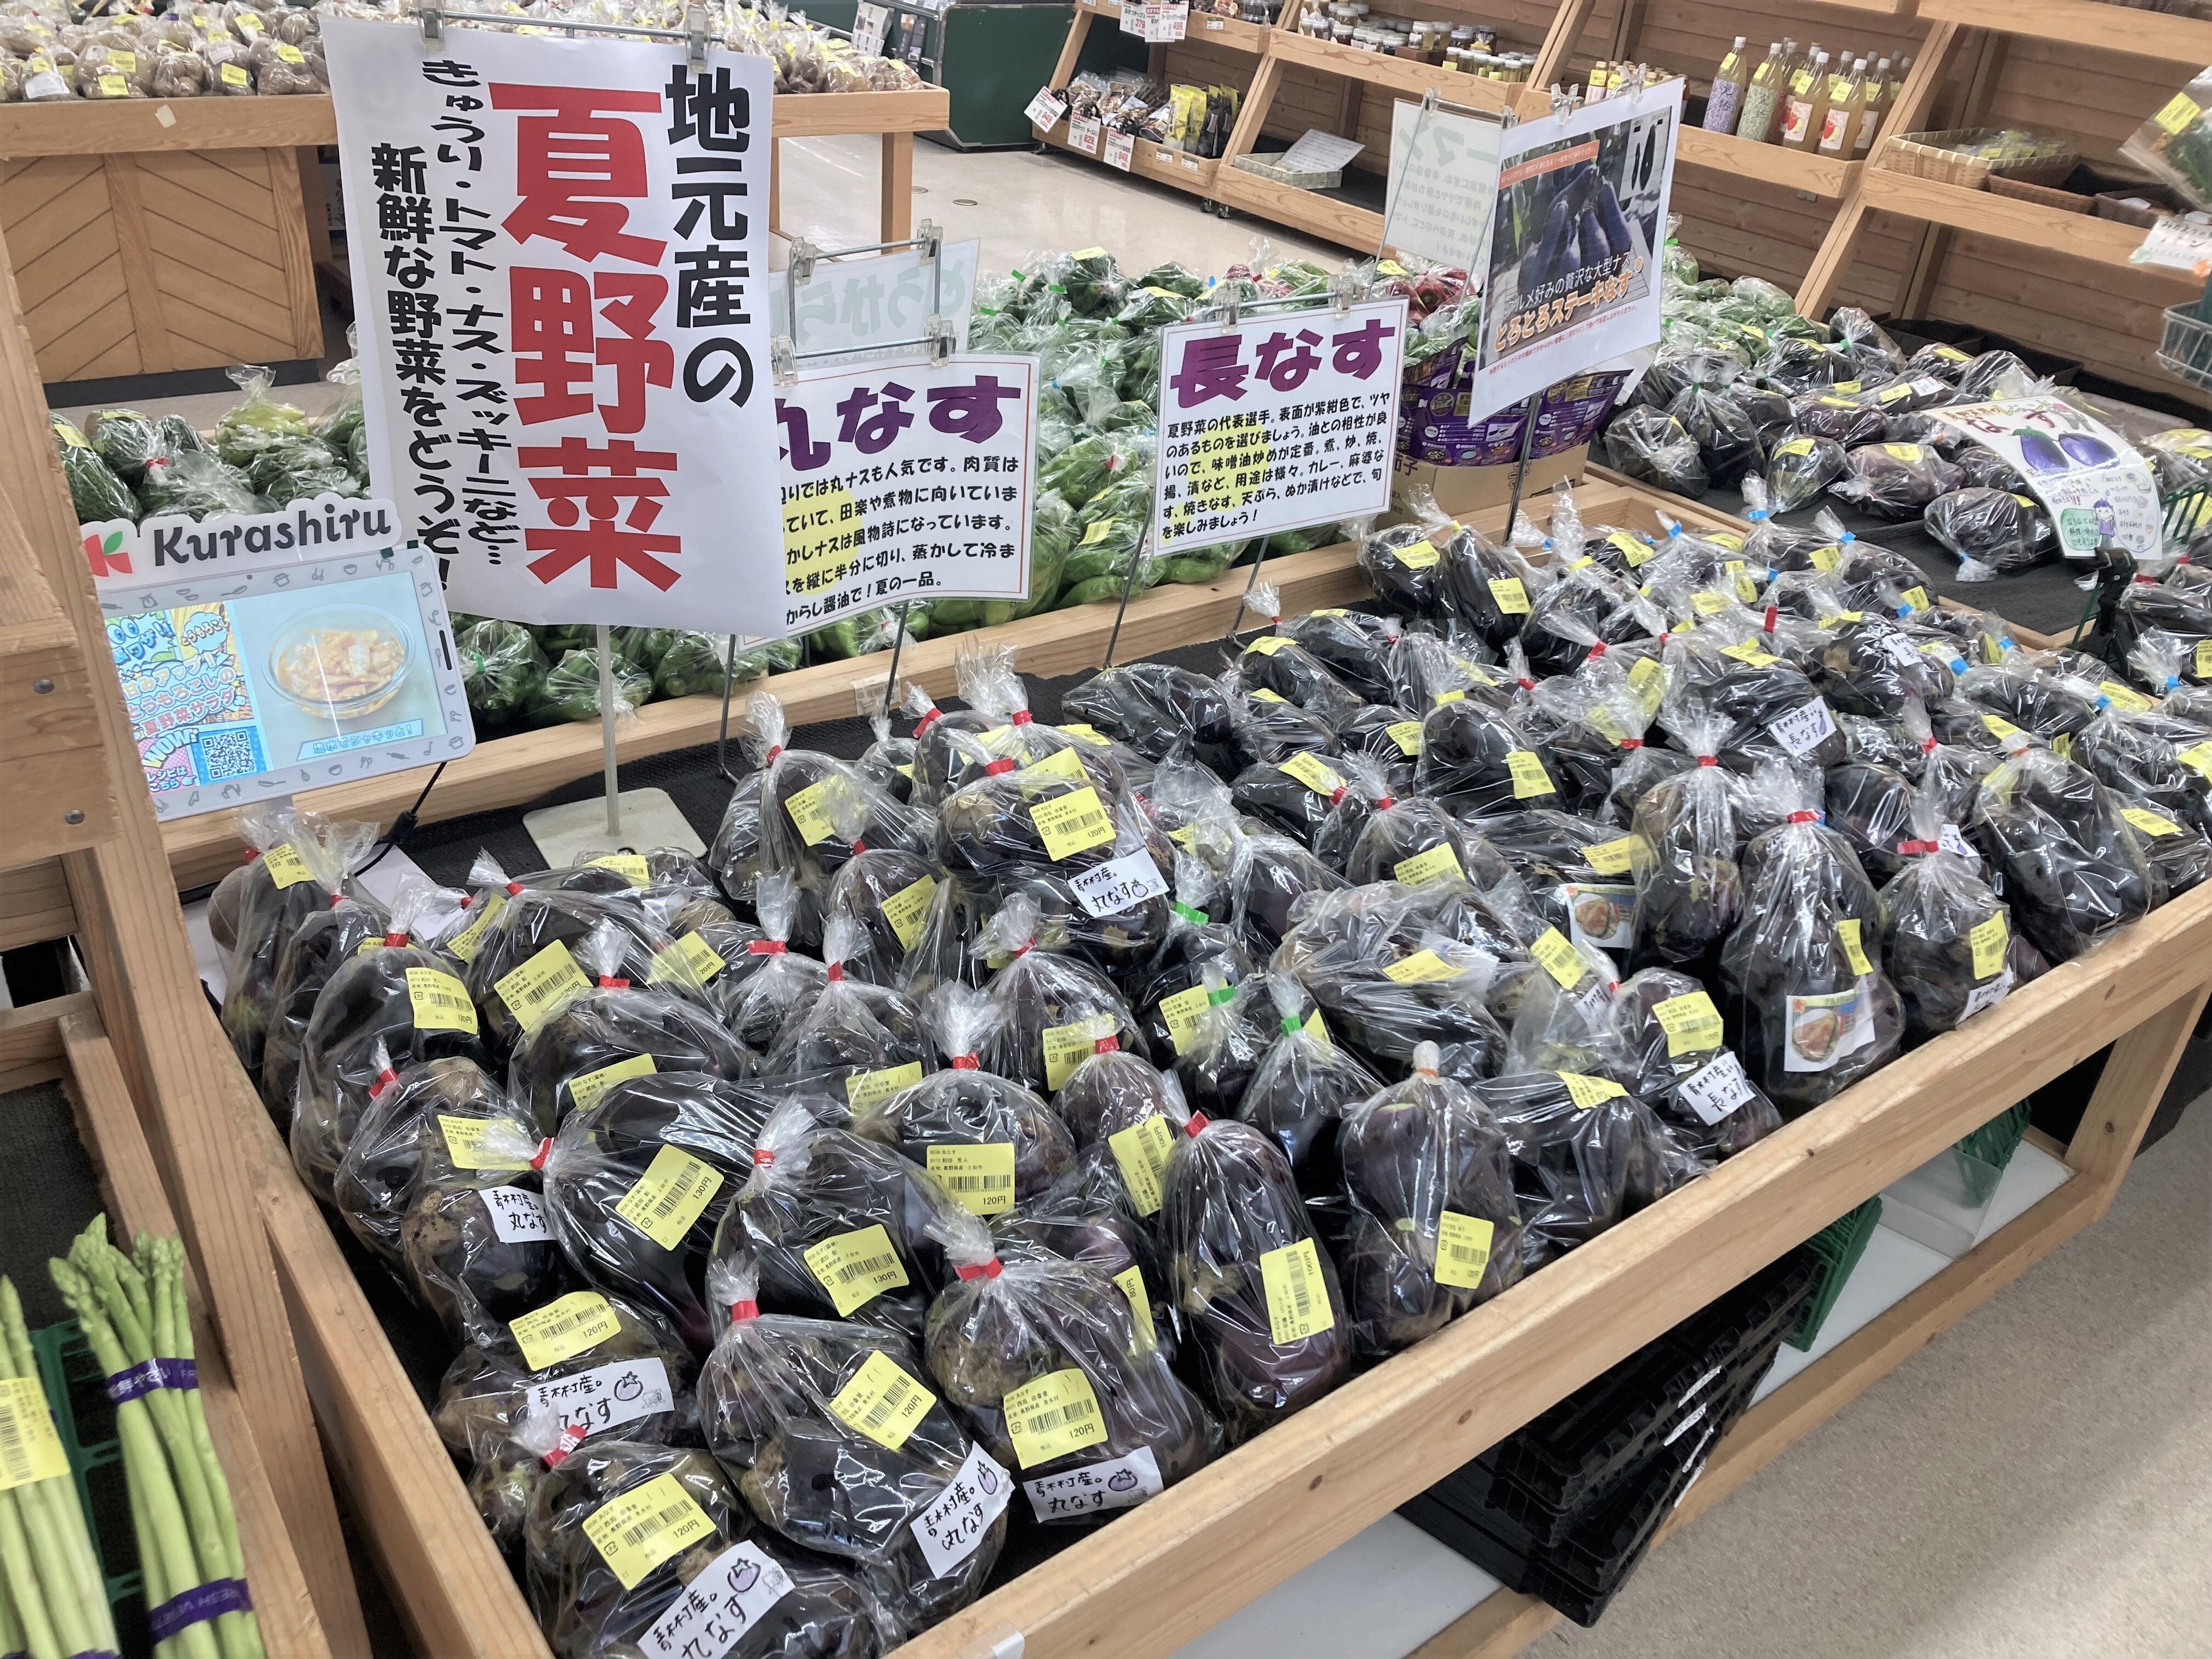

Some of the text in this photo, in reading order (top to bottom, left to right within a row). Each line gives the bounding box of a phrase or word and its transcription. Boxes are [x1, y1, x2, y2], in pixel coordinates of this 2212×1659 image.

[664, 64, 754, 408] 地元産の
[1506, 251, 1630, 317] グルメ好みの贅沢な大型ナス
[1494, 269, 1632, 352] とろとろステーキなす
[488, 82, 682, 592] 夏野菜
[371, 143, 461, 590] 新鮮な野菜をどうぞ！
[1170, 319, 1395, 408] 長なす
[1167, 392, 1390, 438] 夏野菜の代表選手。表面が紫紺色で、ツヤ
[1166, 411, 1387, 457] のあるものを選びましょう。油との相性が良
[1166, 432, 1382, 479] いので、味噌油炒めが定番。煮、炒、焼、
[1164, 449, 1384, 500] 揚、漬など、用途は様々。カレー、麻婆な
[1163, 469, 1381, 520] す、焼きなす、天ぷら、ぬか漬けなどで、旬
[154, 504, 391, 567] Kurashiru
[1162, 510, 1258, 539] を楽しみましょう！
[181, 619, 229, 646] とうもろこし
[127, 667, 236, 719] とうもろこしの
[140, 687, 235, 736] 夏野菜サラダ
[146, 767, 188, 782] レシピは
[149, 779, 179, 792] こちら
[1088, 826, 1106, 839] 120円
[1091, 881, 1132, 912] 丸なす
[457, 1014, 472, 1024] 120円
[1154, 1126, 1167, 1149] 100円
[693, 1176, 713, 1200] 130円
[982, 1195, 1006, 1205] 120円
[641, 1194, 657, 1214] 長野県産
[509, 1211, 547, 1234] 丸なす
[825, 1256, 842, 1271] 長野県産
[845, 1250, 860, 1259] 上田市
[1303, 1250, 1315, 1277] 100円
[873, 1271, 898, 1284] 130円
[582, 1321, 608, 1339] 120円
[901, 1395, 923, 1419] 120円
[1020, 1402, 1040, 1414] 長野県産
[1043, 1395, 1059, 1406] 青木村
[1069, 1423, 1095, 1438] 120円
[1048, 1489, 1106, 1514] 丸なす
[672, 1519, 701, 1538] 120円
[941, 1502, 985, 1551] 丸なす
[682, 1593, 751, 1659] 丸なす
